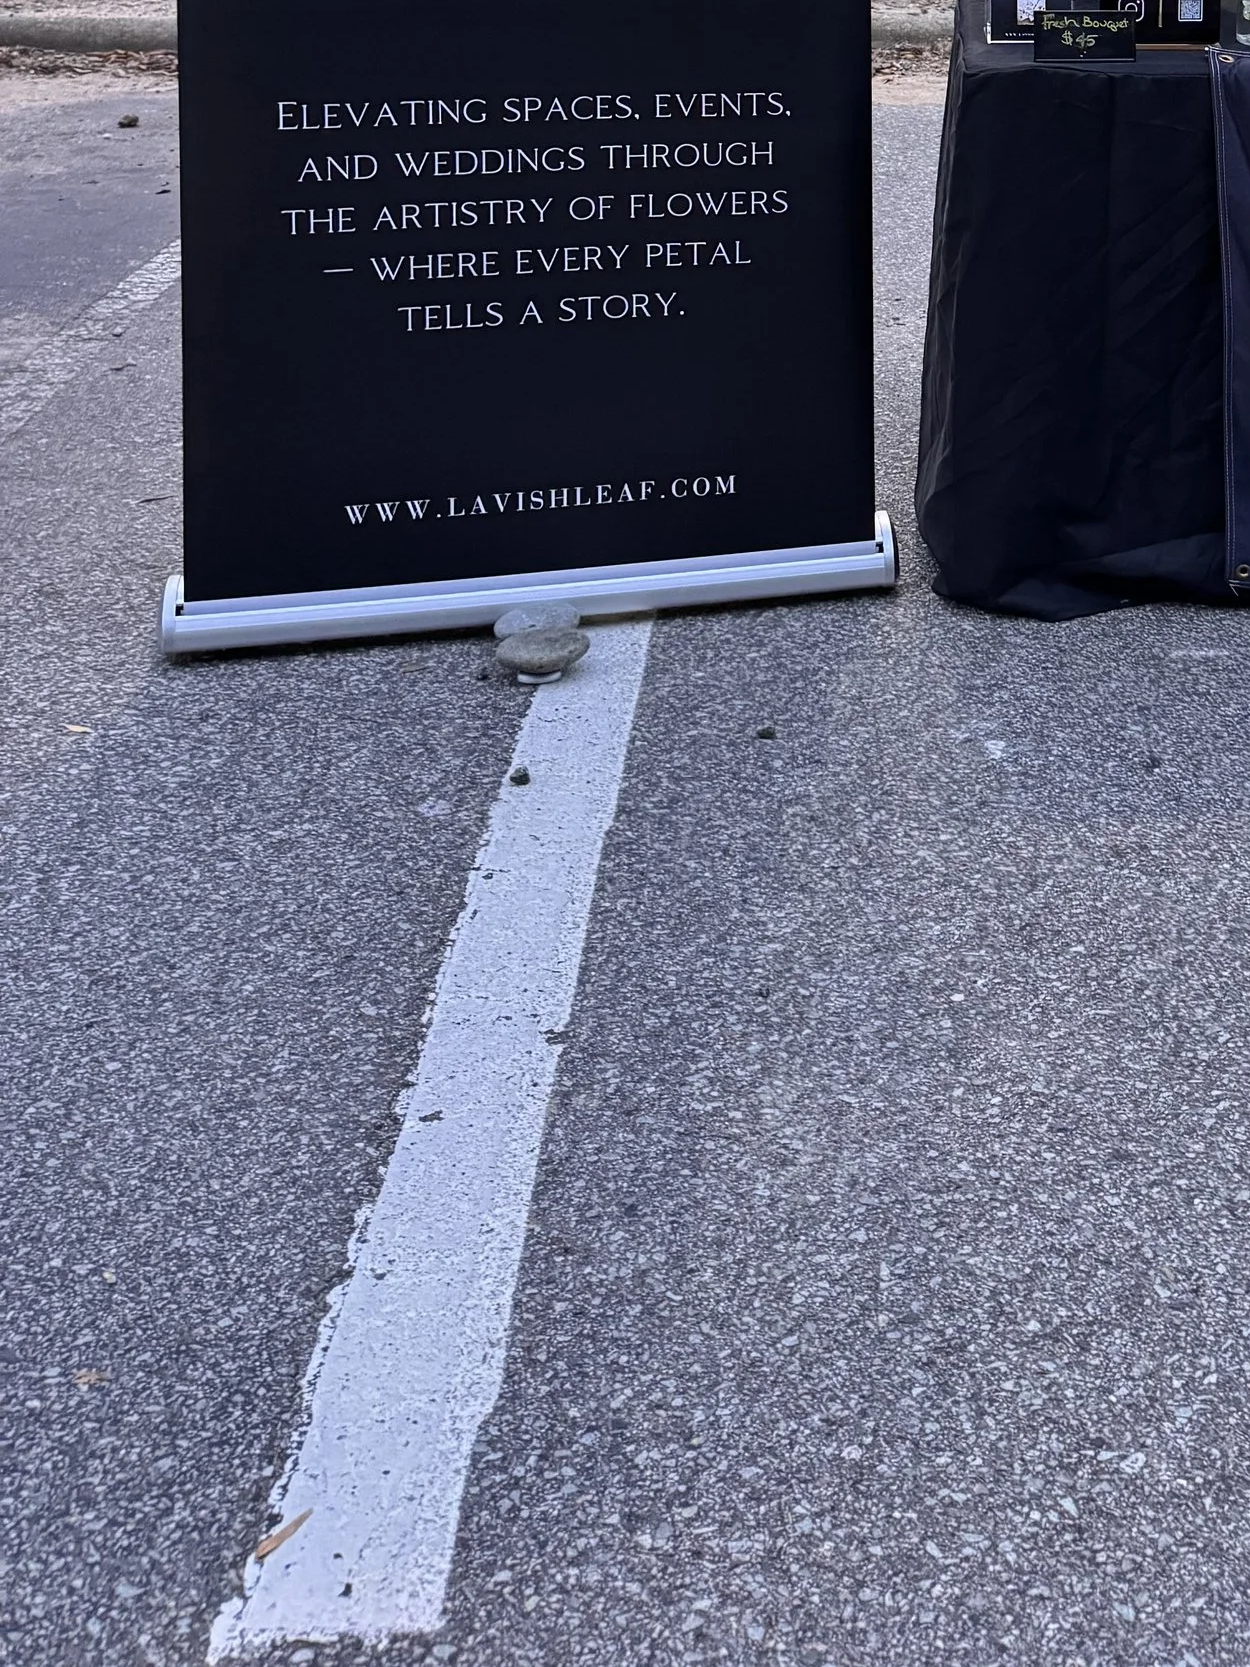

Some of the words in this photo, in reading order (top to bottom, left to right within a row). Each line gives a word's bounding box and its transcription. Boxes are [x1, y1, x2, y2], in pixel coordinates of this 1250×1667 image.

[278, 99, 486, 130] ELEVATING
[504, 95, 639, 122] SPACES,
[656, 93, 790, 117] EVENTS,
[298, 155, 377, 182] AND
[396, 147, 584, 176] WEDDINGS
[601, 142, 772, 169] THROUGH
[282, 208, 355, 234] THE
[374, 198, 552, 230] ARTISTRY
[569, 196, 614, 220] OF
[631, 190, 788, 218] FLOWERS
[371, 252, 499, 280] WHERE
[517, 245, 628, 274] EVERY
[647, 241, 751, 267] PETAL
[398, 302, 503, 331] TELLS
[520, 301, 542, 324] A
[559, 293, 684, 321] STORY.
[346, 475, 734, 524] WWW.LAVISHLEAF.COM
